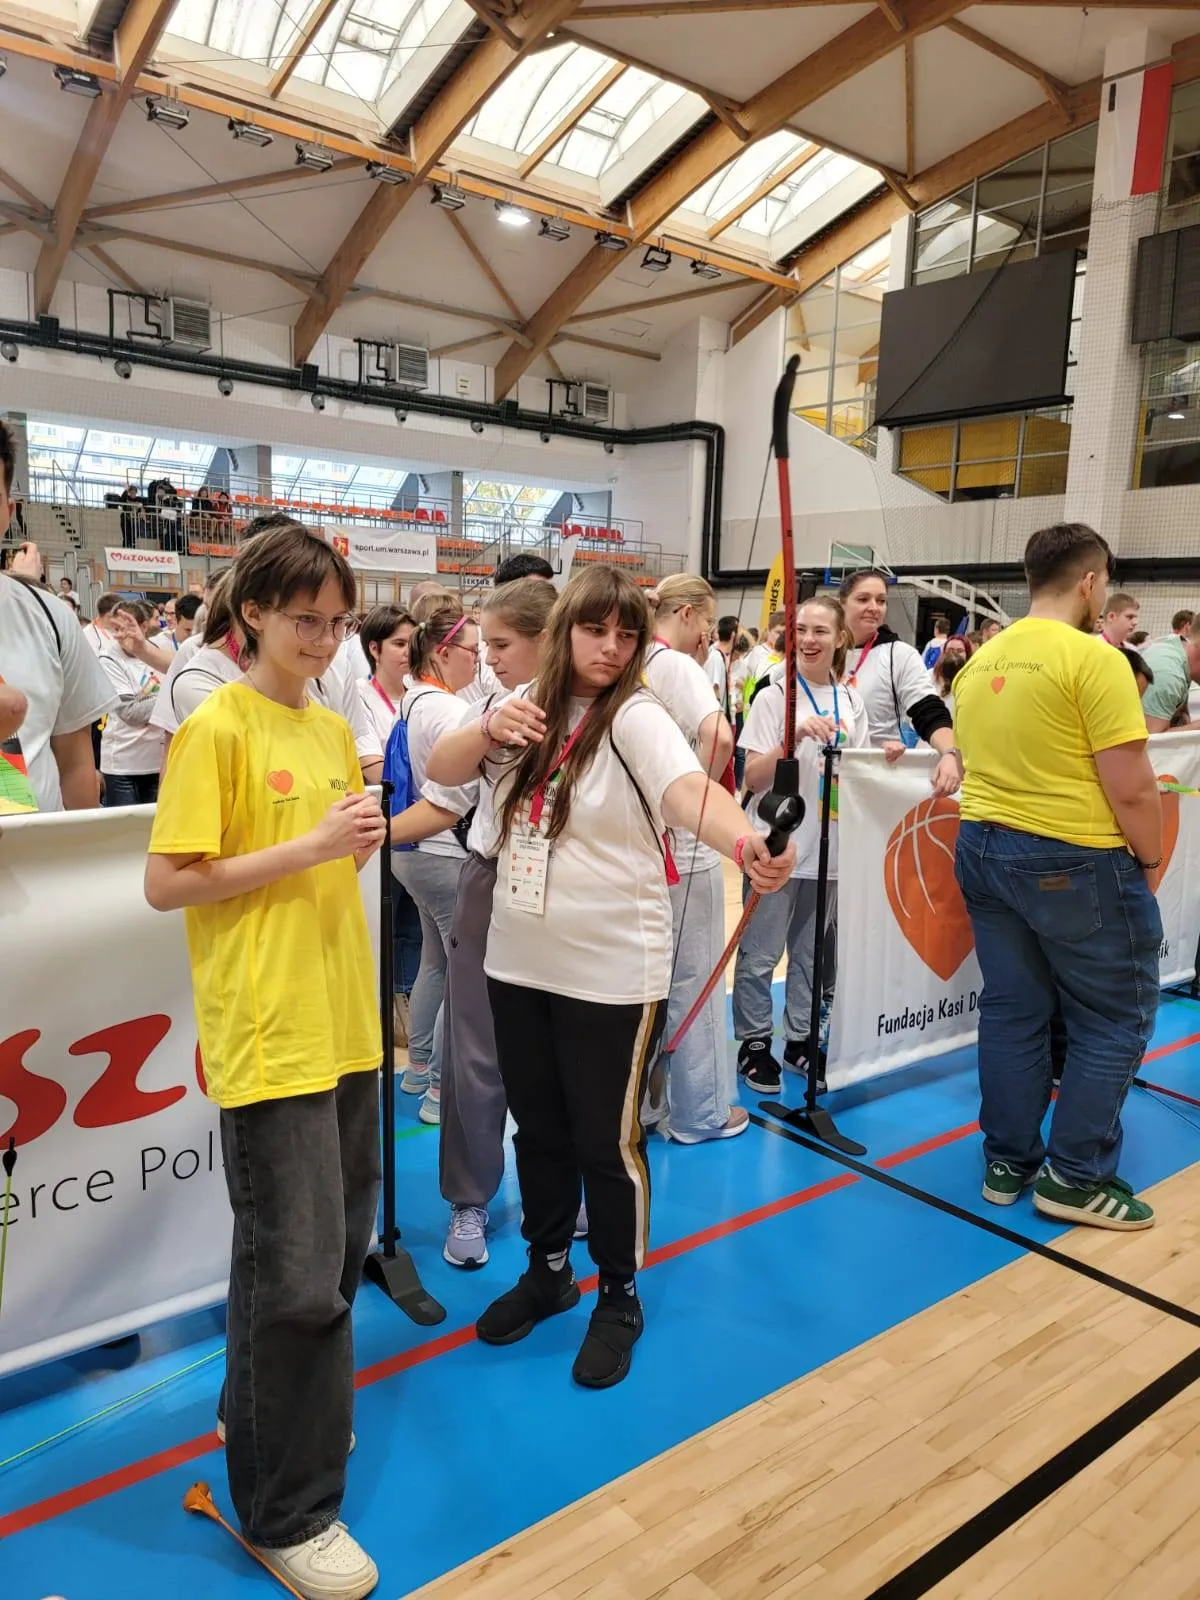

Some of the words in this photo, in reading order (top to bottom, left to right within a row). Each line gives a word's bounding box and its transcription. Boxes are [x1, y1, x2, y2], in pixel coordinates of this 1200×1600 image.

[355, 544, 429, 557] sport.um.warszawa.pl
[877, 1003, 934, 1037] Fundacja
[938, 995, 964, 1020] Kasi
[0, 1013, 207, 1151] sz
[0, 1170, 114, 1226] erce
[141, 1130, 224, 1191] Pol
